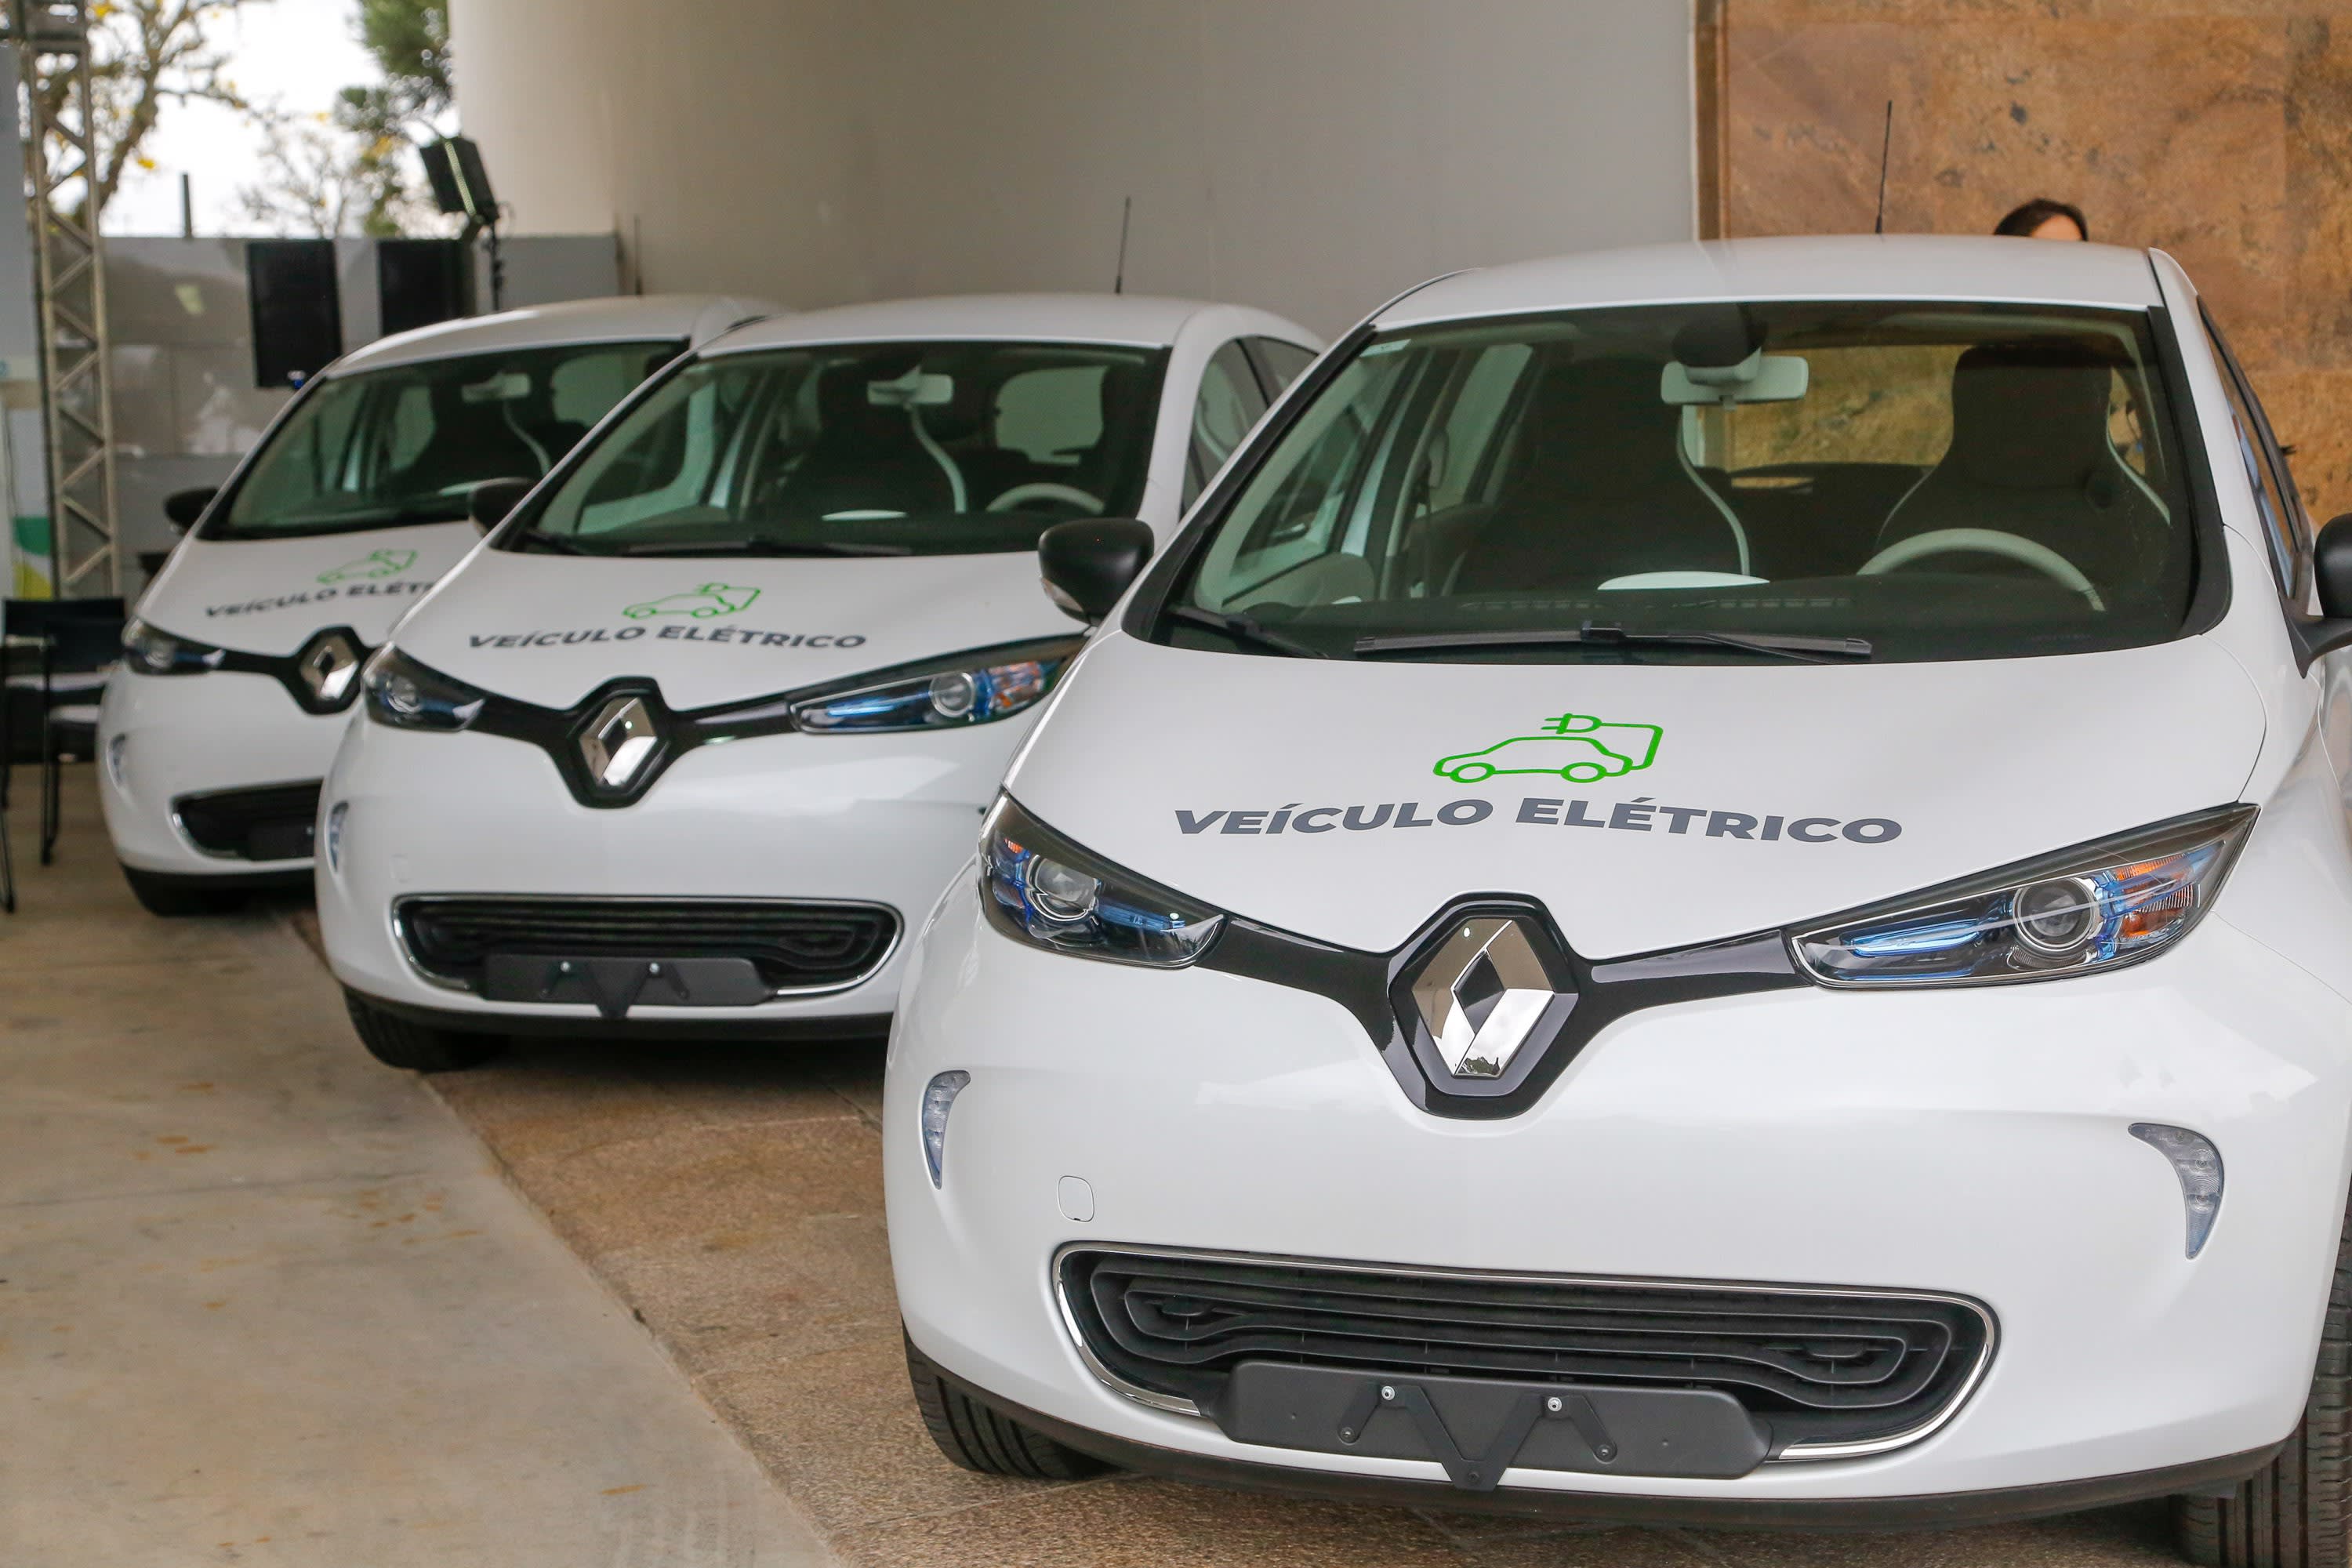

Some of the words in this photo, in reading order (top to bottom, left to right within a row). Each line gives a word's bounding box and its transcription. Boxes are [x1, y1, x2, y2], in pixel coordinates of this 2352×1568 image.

[469, 626, 645, 648] VEÍCULO
[656, 625, 866, 648] ELÉTRICO
[1175, 800, 1494, 834] VEÍCULO
[1515, 797, 1902, 844] ELÉTRICO
